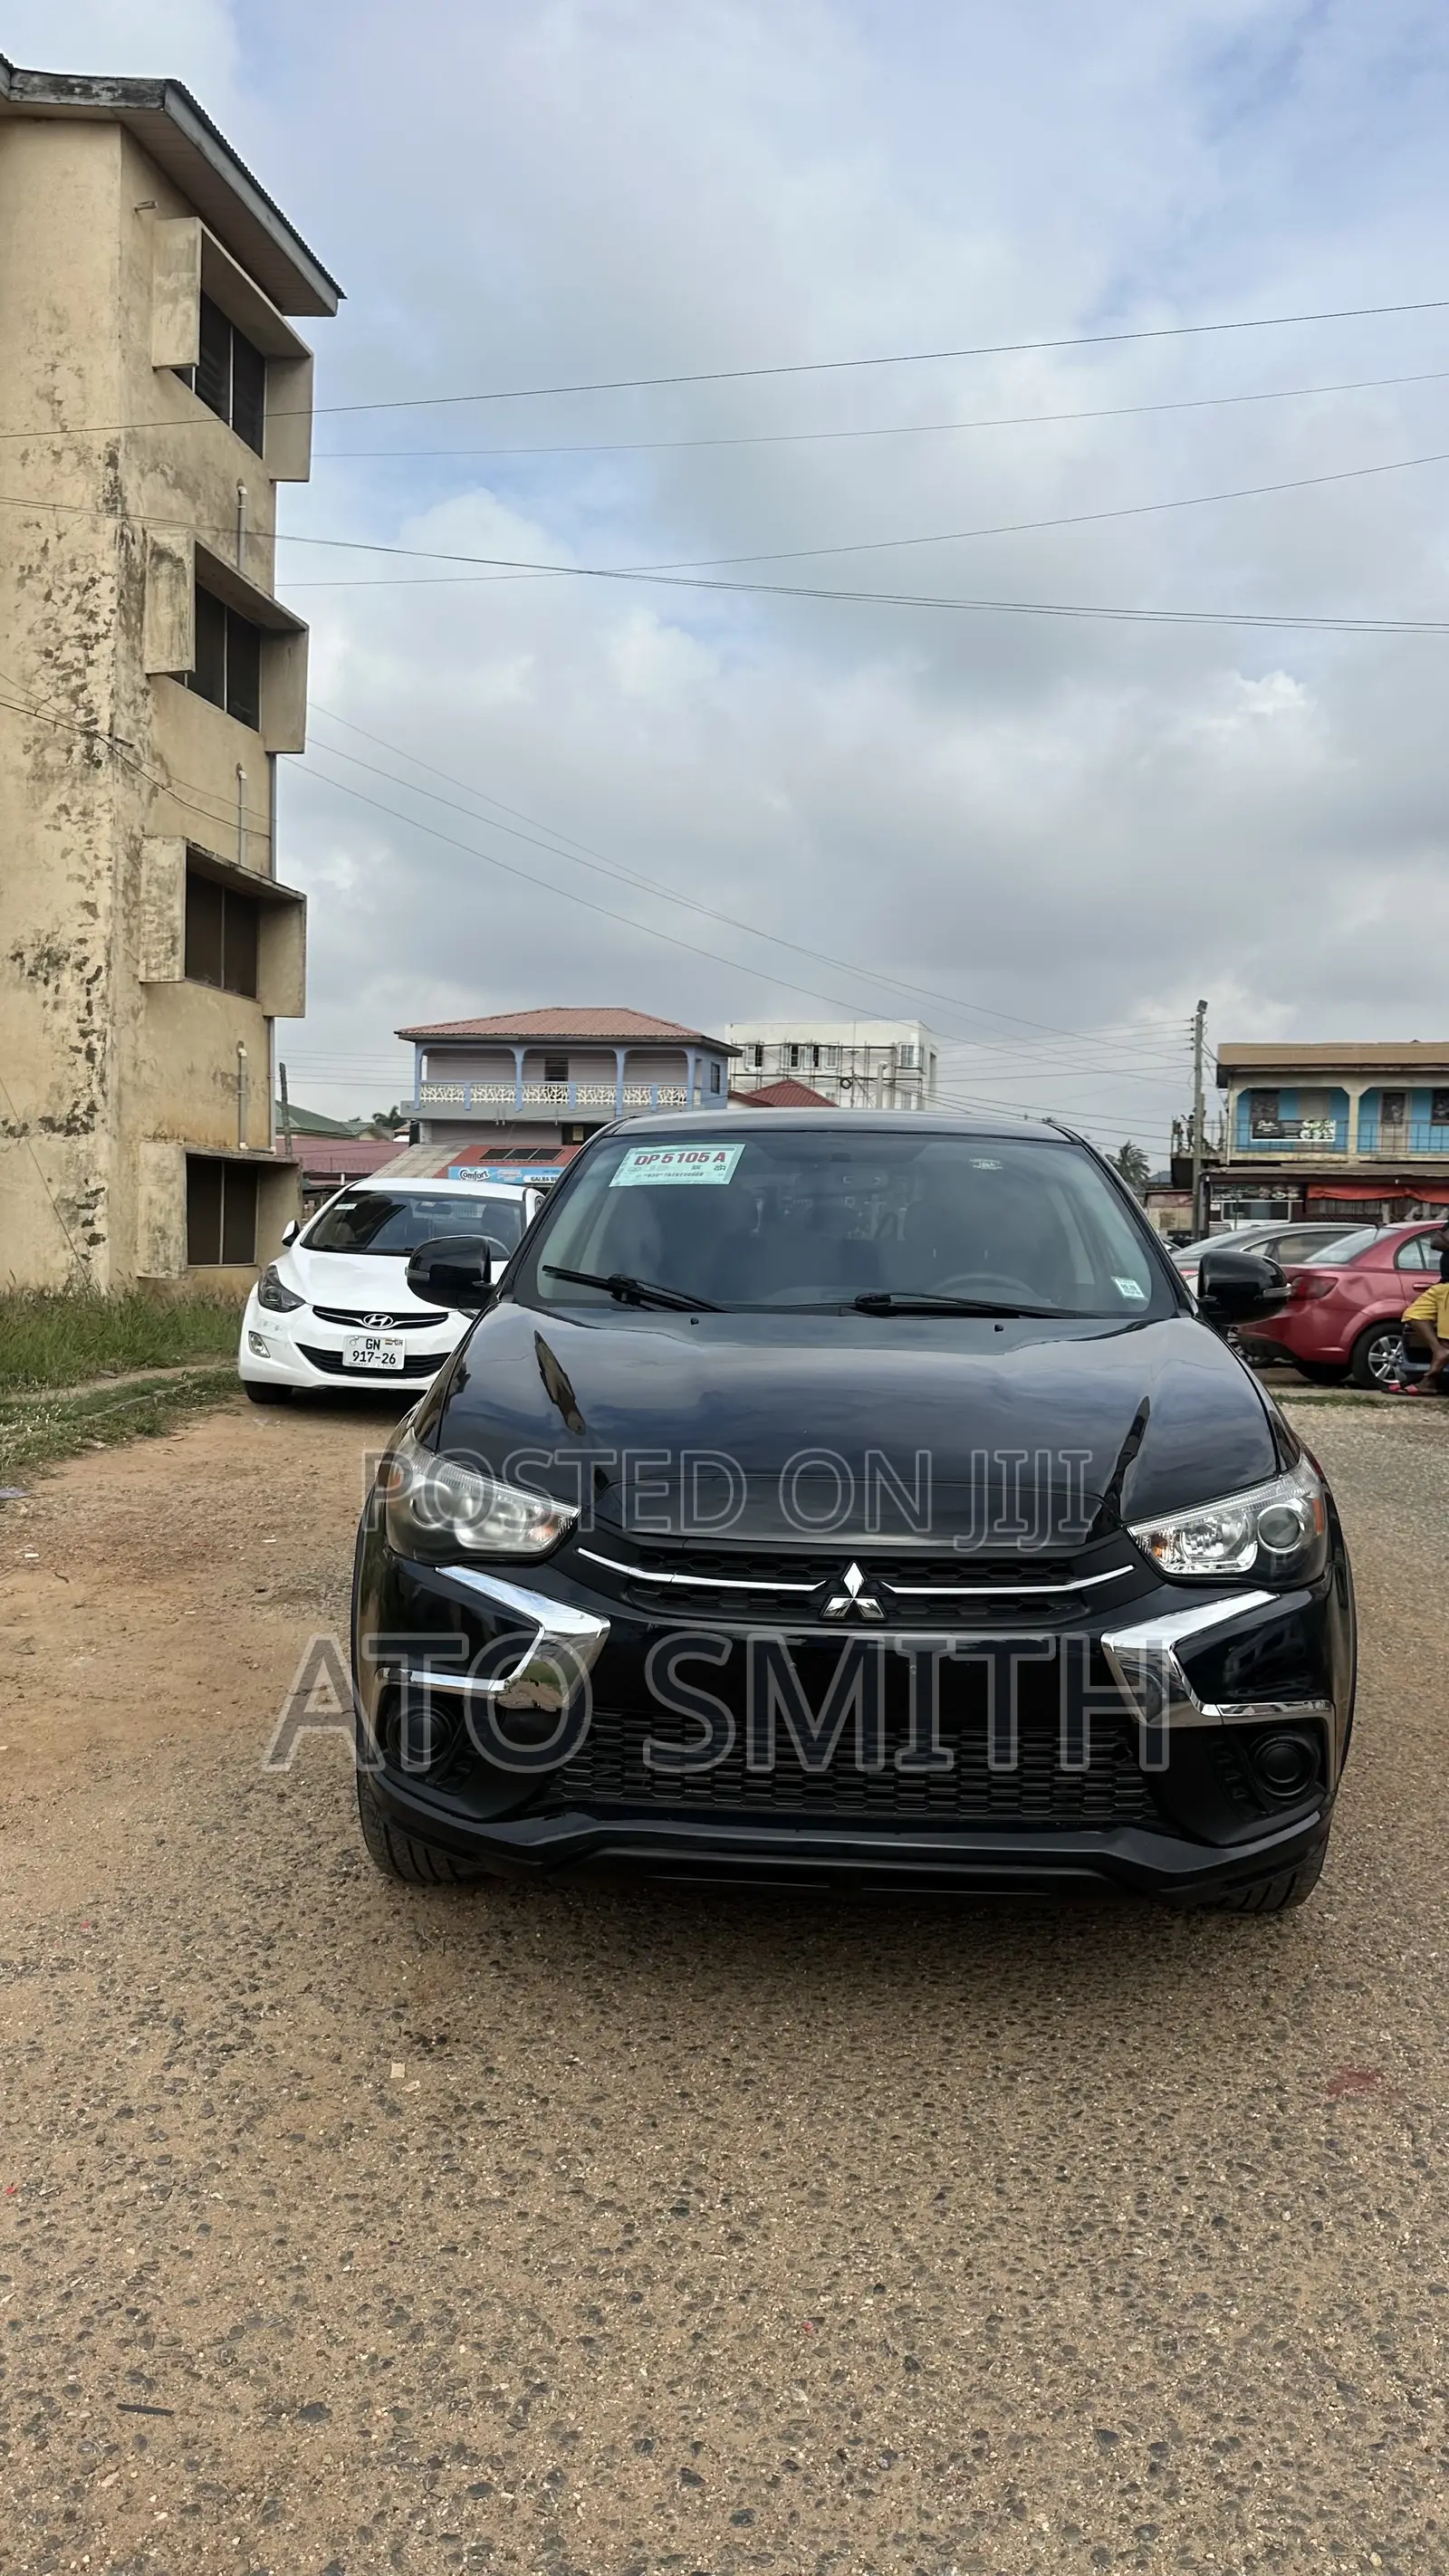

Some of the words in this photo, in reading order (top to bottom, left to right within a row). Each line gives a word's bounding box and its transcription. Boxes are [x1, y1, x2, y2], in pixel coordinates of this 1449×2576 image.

[634, 1154, 660, 1165] DP
[661, 1152, 712, 1164] 5105
[712, 1152, 726, 1163] A
[459, 1169, 489, 1181] Comfort
[366, 1338, 380, 1350] GN
[352, 1350, 396, 1365] 917-26
